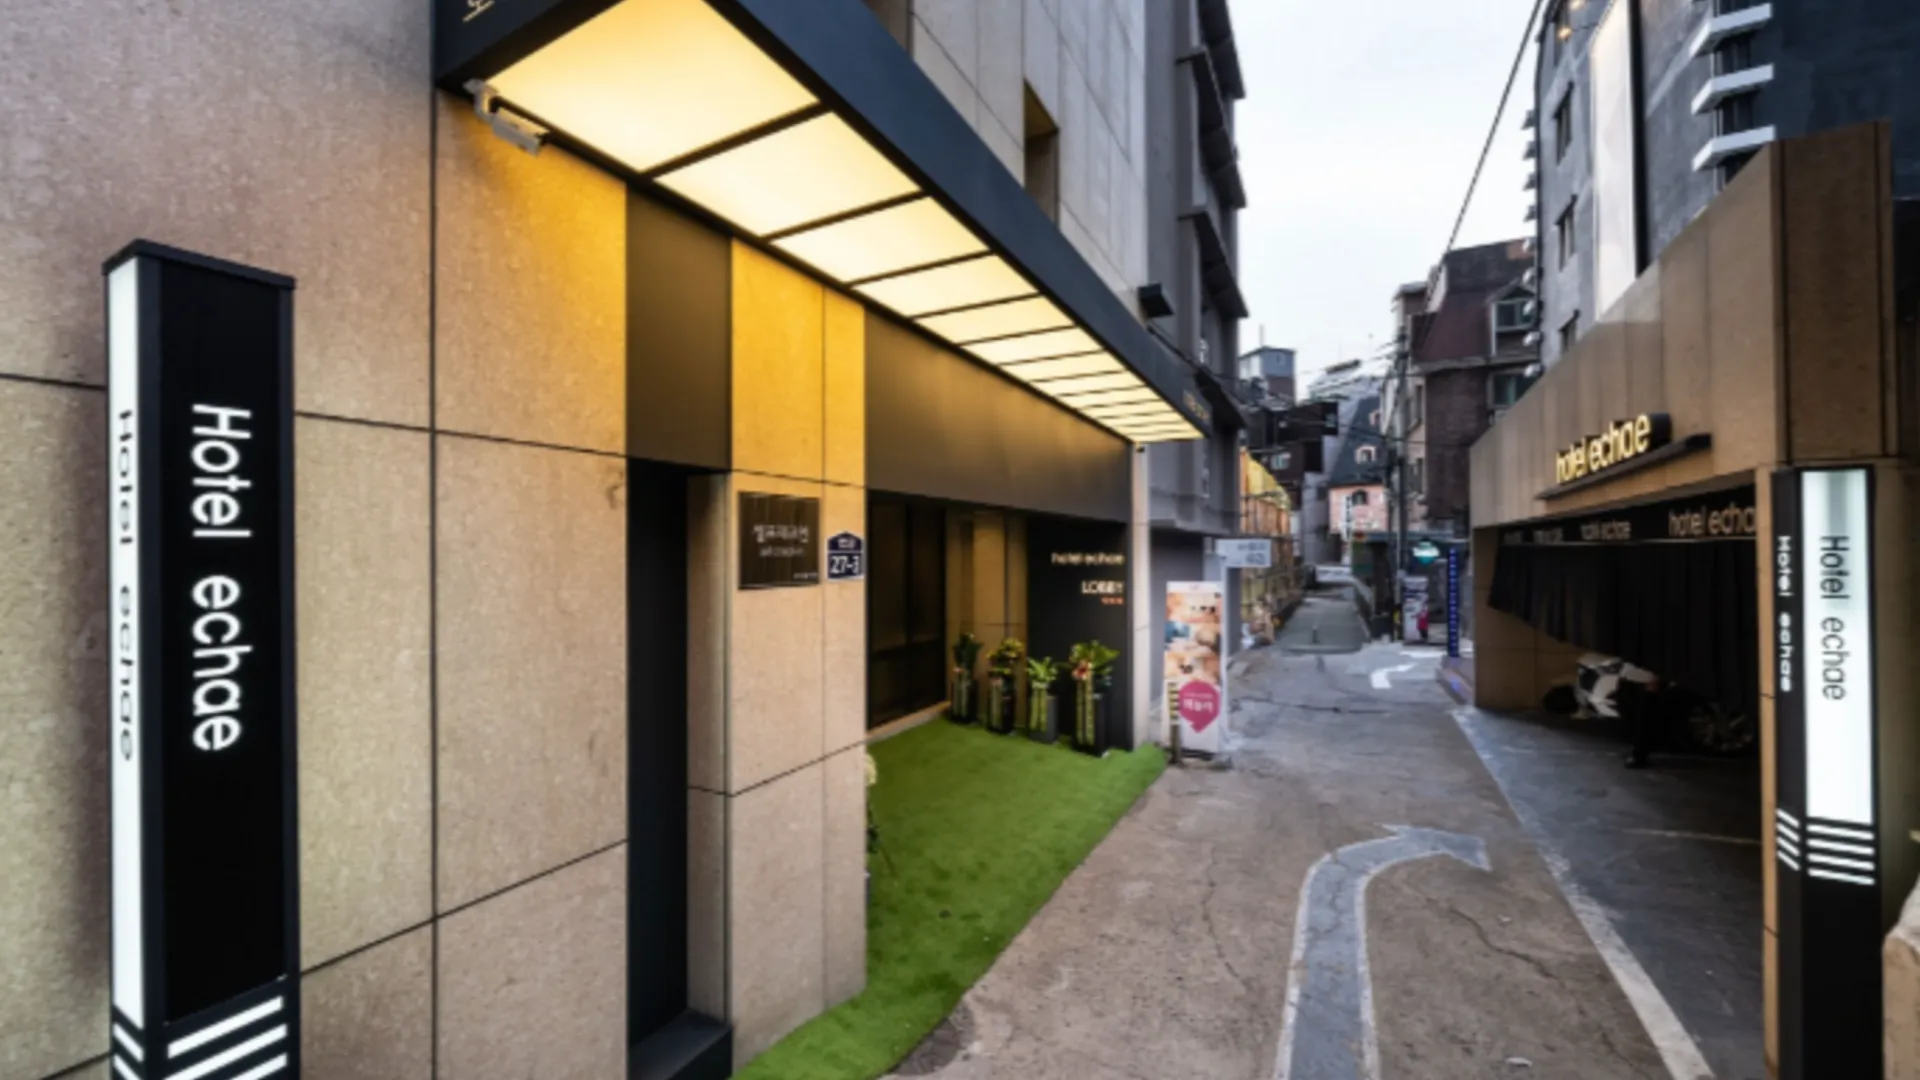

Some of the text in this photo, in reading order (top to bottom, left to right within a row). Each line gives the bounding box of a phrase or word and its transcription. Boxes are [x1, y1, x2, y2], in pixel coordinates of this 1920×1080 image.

[1555, 414, 1650, 484] hotel echae
[191, 403, 253, 751] Hotel echae
[1820, 536, 1851, 701] Hotel echae
